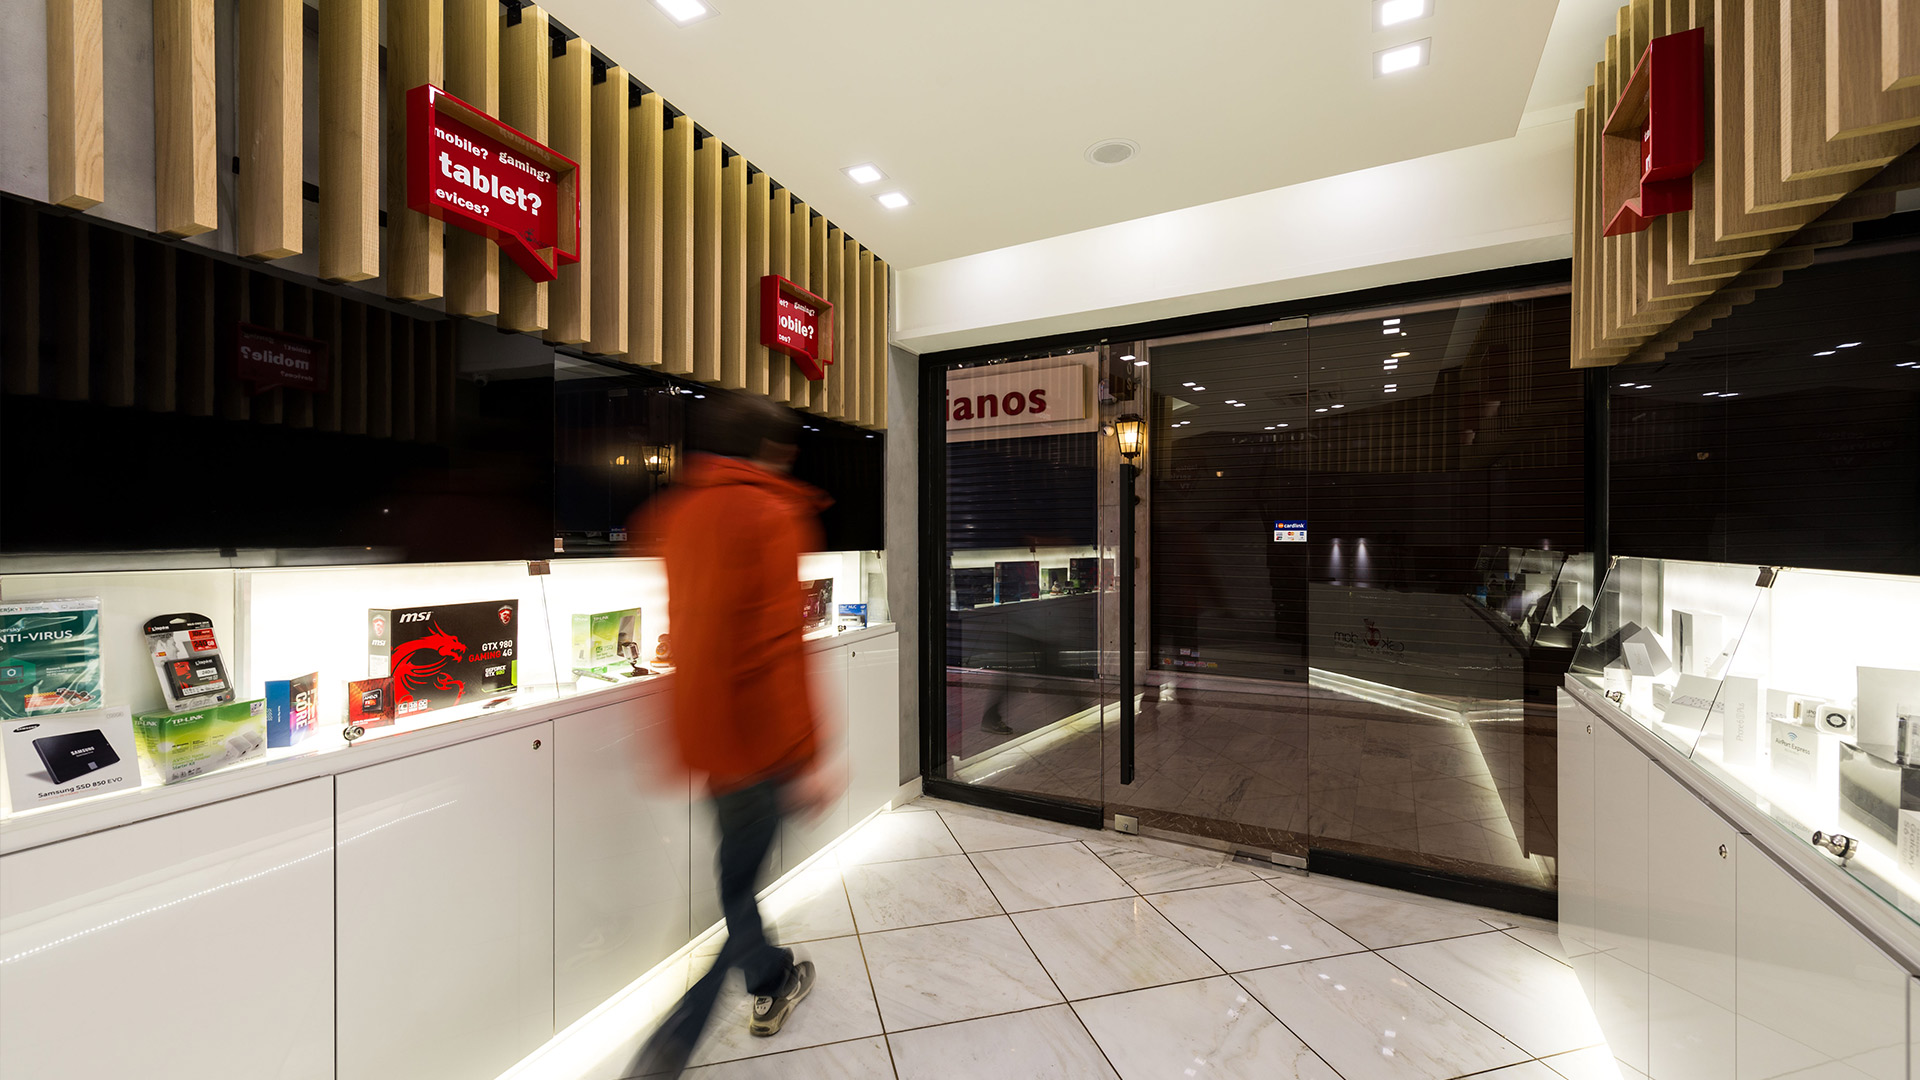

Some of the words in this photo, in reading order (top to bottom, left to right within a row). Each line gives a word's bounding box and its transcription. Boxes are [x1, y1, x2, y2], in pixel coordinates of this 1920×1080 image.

[434, 127, 489, 160] mobile?
[498, 150, 551, 184] gaming?
[438, 151, 542, 216] tablet?
[778, 315, 814, 340] obile?
[400, 611, 432, 623] msi
[482, 642, 498, 651] GTX
[499, 640, 513, 649] 980
[468, 650, 501, 662] GAMING
[502, 648, 512, 657] 4G
[296, 691, 308, 730] CORE
[172, 714, 204, 724] TP-LINK
[70, 746, 95, 756] SAMSUNG
[38, 787, 75, 798] Samsung
